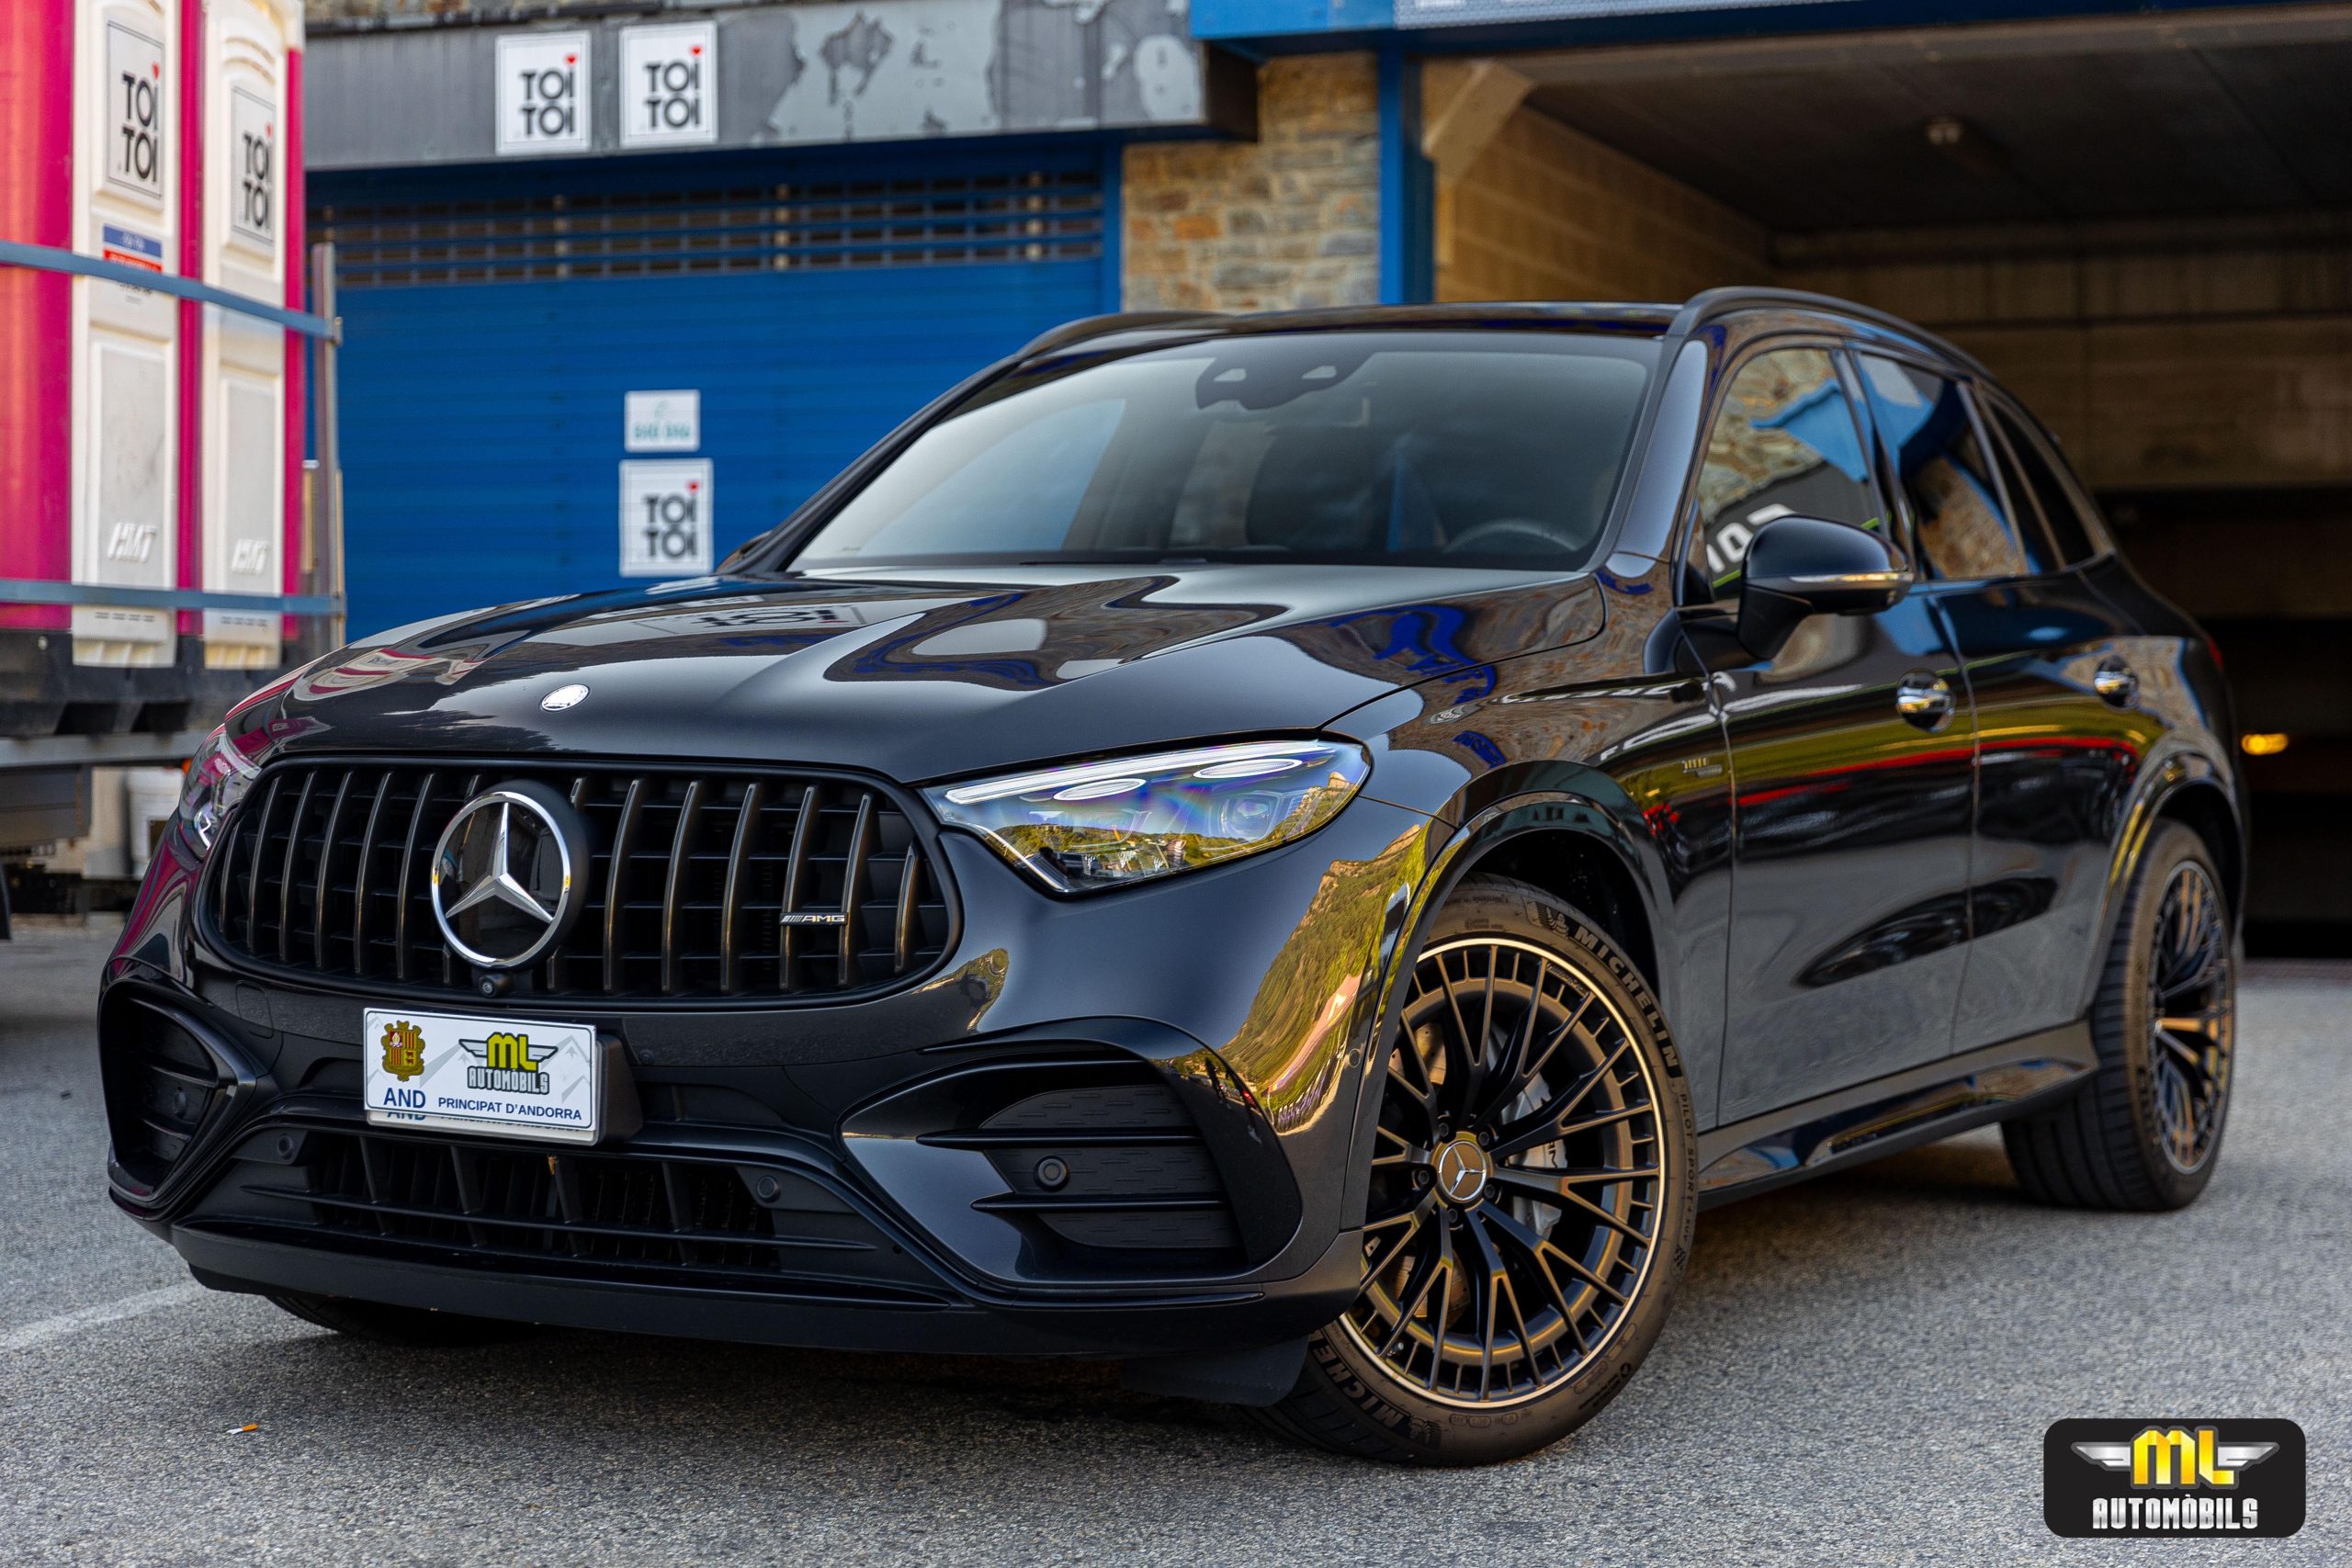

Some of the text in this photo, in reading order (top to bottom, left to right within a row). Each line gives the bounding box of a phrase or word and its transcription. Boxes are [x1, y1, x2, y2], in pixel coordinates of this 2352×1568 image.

[521, 105, 574, 136] TOI
[646, 96, 702, 129] TOI
[121, 125, 158, 183] TOI
[645, 528, 698, 558] TOI
[1574, 925, 1679, 1067] MICHELIN
[487, 1032, 537, 1072] ML
[383, 1087, 426, 1109] AND
[438, 1097, 582, 1121] PRINCIPAT D'ANDORRA
[1679, 1093, 1693, 1139] PILOT
[1686, 1147, 1695, 1202] SPORT
[1308, 1329, 1405, 1428] MICHE
